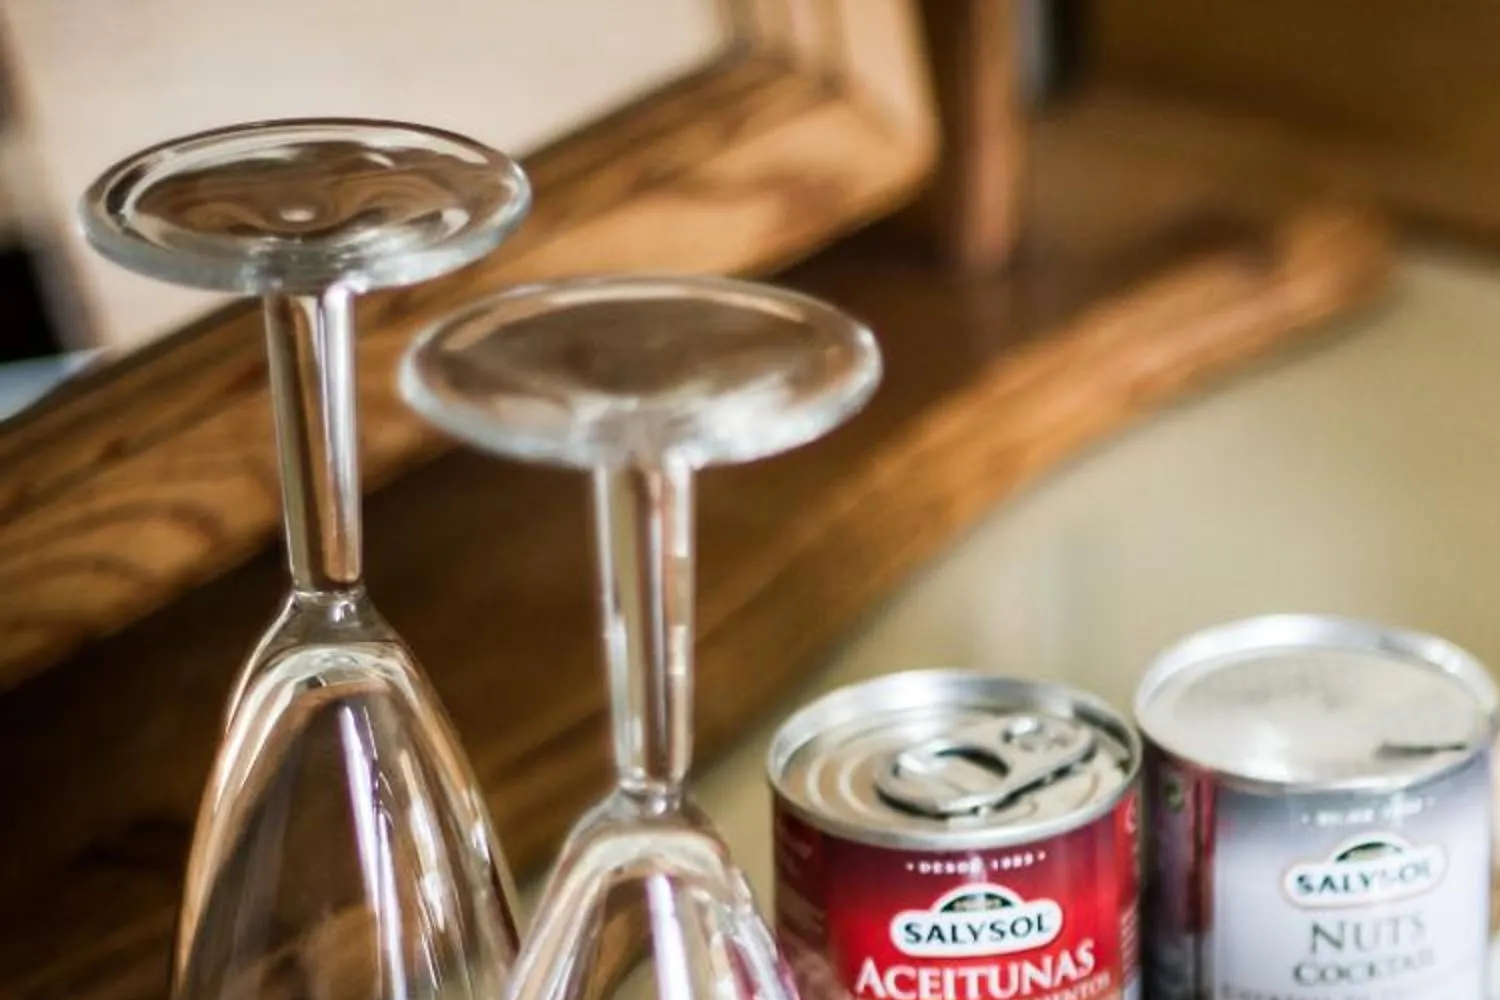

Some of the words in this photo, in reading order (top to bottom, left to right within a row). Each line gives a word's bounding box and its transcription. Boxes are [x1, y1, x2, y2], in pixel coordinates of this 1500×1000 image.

[1296, 858, 1431, 896] SALYSOL
[903, 912, 1051, 946] SALYSOL
[1310, 911, 1426, 955] NUTS
